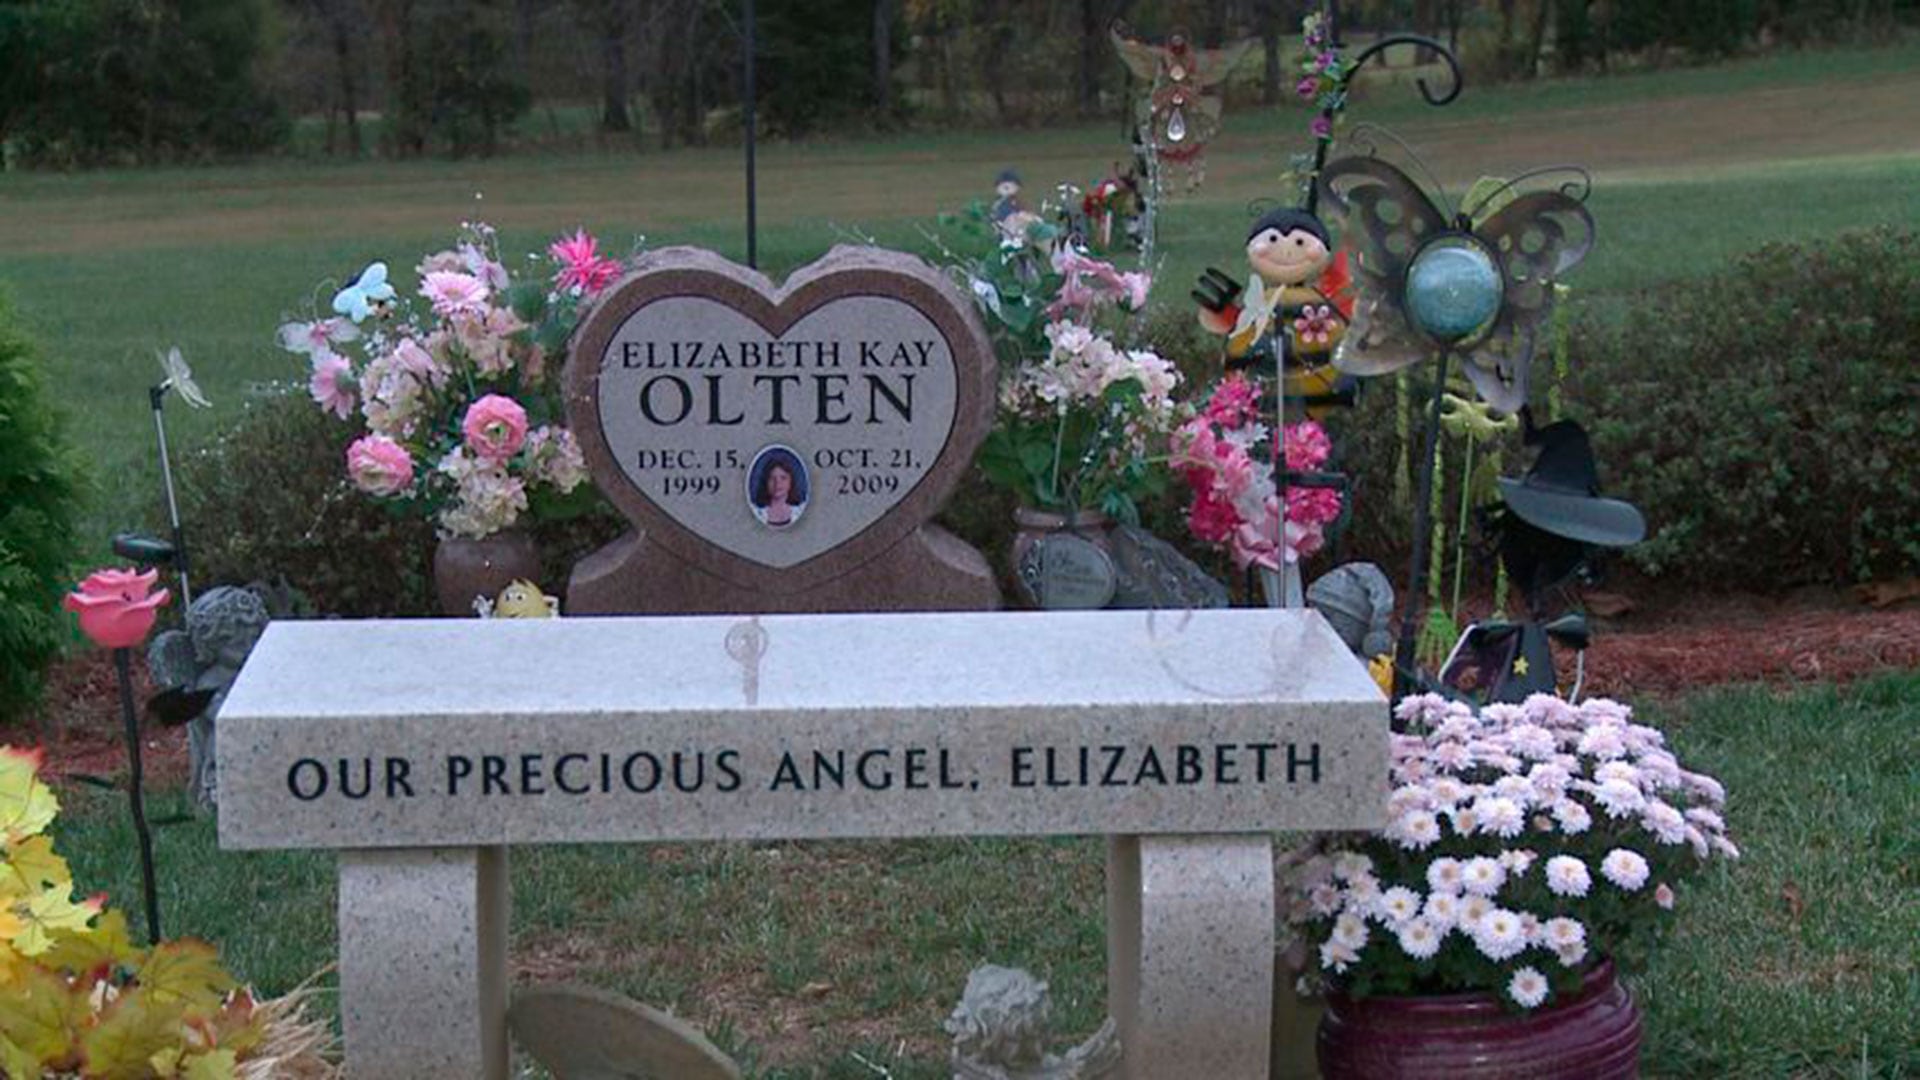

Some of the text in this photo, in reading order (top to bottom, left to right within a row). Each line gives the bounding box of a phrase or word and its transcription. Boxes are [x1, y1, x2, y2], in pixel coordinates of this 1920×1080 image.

[621, 341, 936, 368] ELIZABETH KAY
[638, 374, 917, 426] OLTEN
[637, 449, 747, 472] DEC. 15,
[814, 448, 923, 471] OCT. 21,
[662, 475, 721, 496] 1999
[837, 474, 900, 496] 2009
[287, 756, 415, 800] OUR
[446, 750, 742, 797] PRECIOUS
[1010, 742, 1323, 788] ELIZABETH
